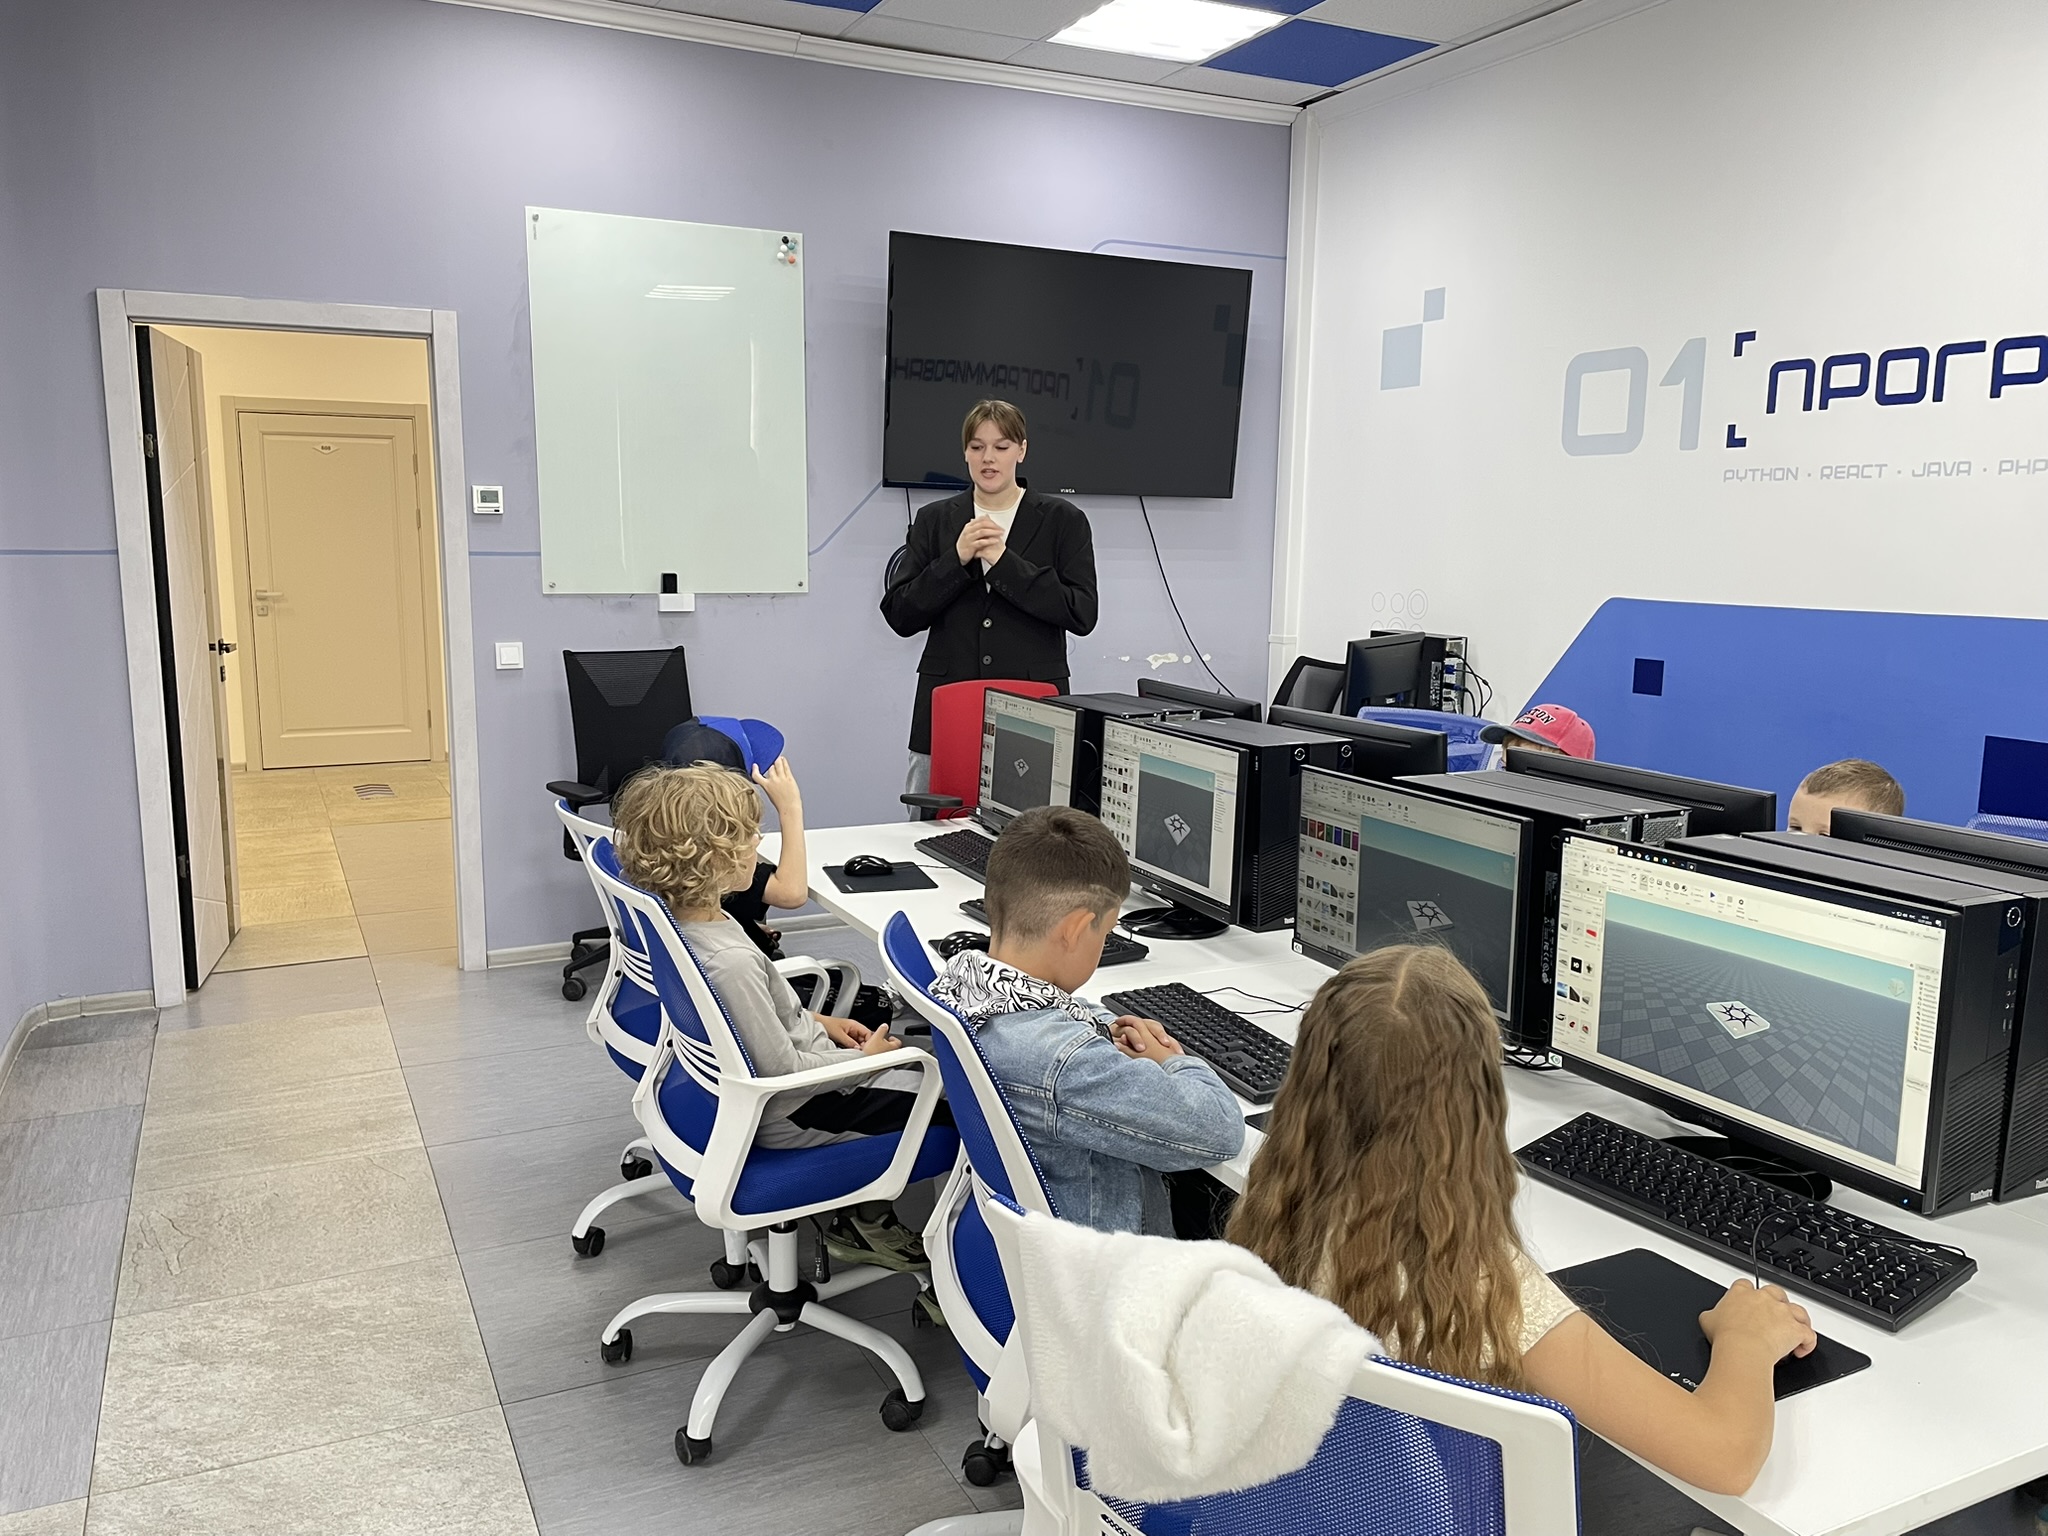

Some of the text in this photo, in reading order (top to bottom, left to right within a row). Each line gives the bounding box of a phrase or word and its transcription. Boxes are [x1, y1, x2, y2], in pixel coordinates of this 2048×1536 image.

[1561, 335, 2048, 457] 01 ПРОГР
[1723, 459, 2048, 483] PYTHON REACT JAVA PHP
